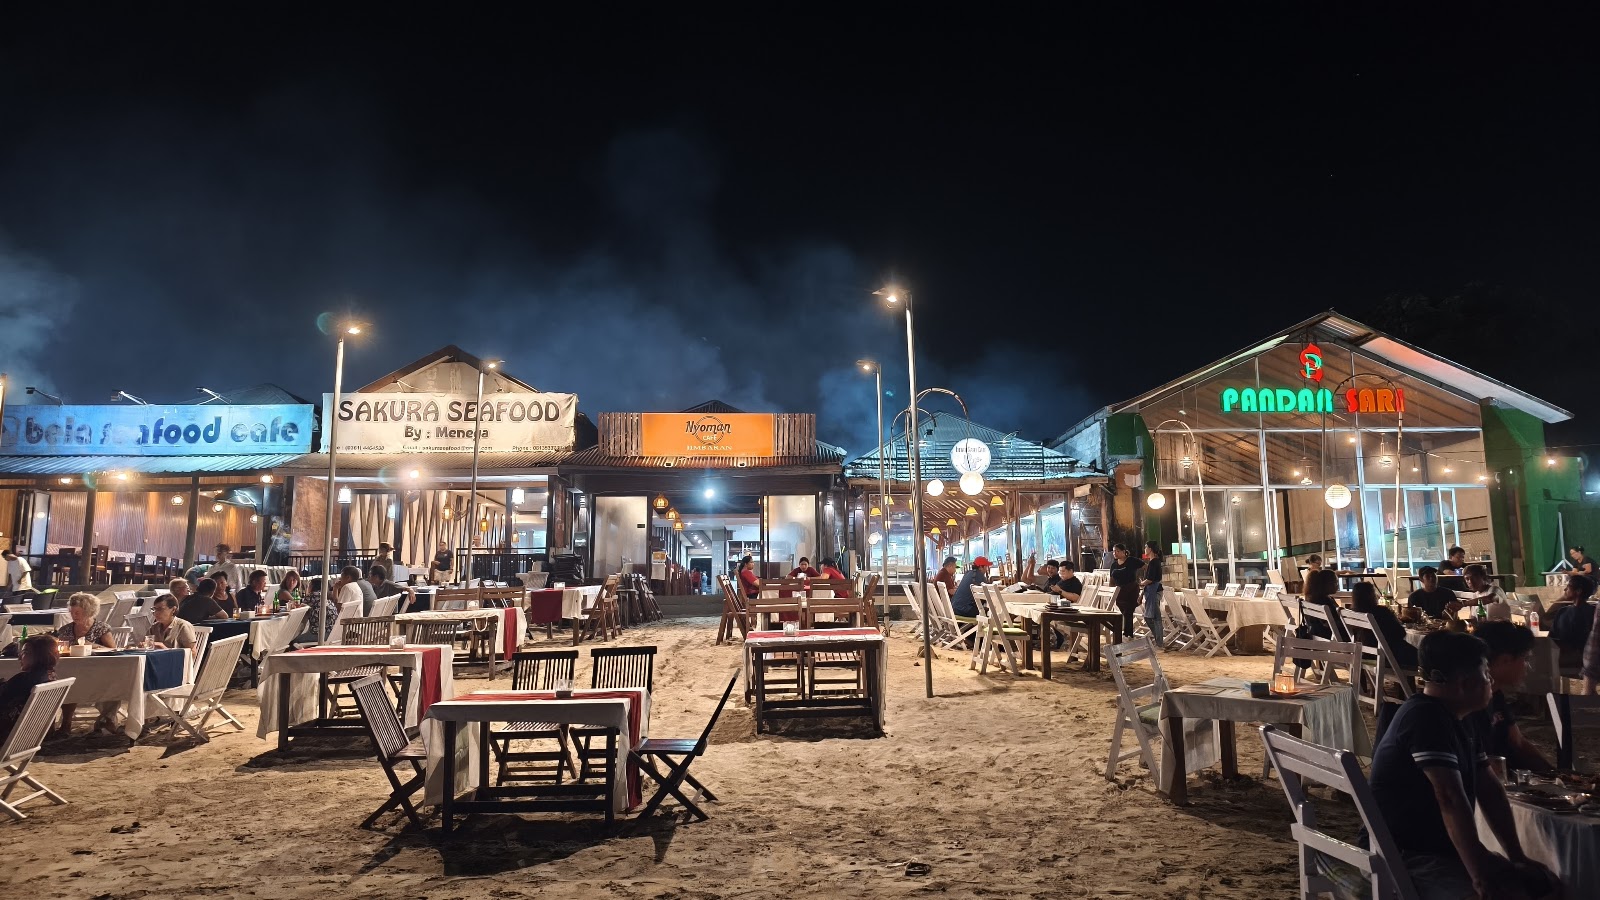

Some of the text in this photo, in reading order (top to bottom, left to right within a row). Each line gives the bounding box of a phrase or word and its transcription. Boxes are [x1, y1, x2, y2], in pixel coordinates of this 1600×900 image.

[338, 400, 560, 422] SAKURA SEAFOOD
[1222, 387, 1405, 413] PANDAN SARI
[230, 415, 299, 443] cafe
[404, 425, 421, 440] By
[685, 420, 732, 435] Nyoman
